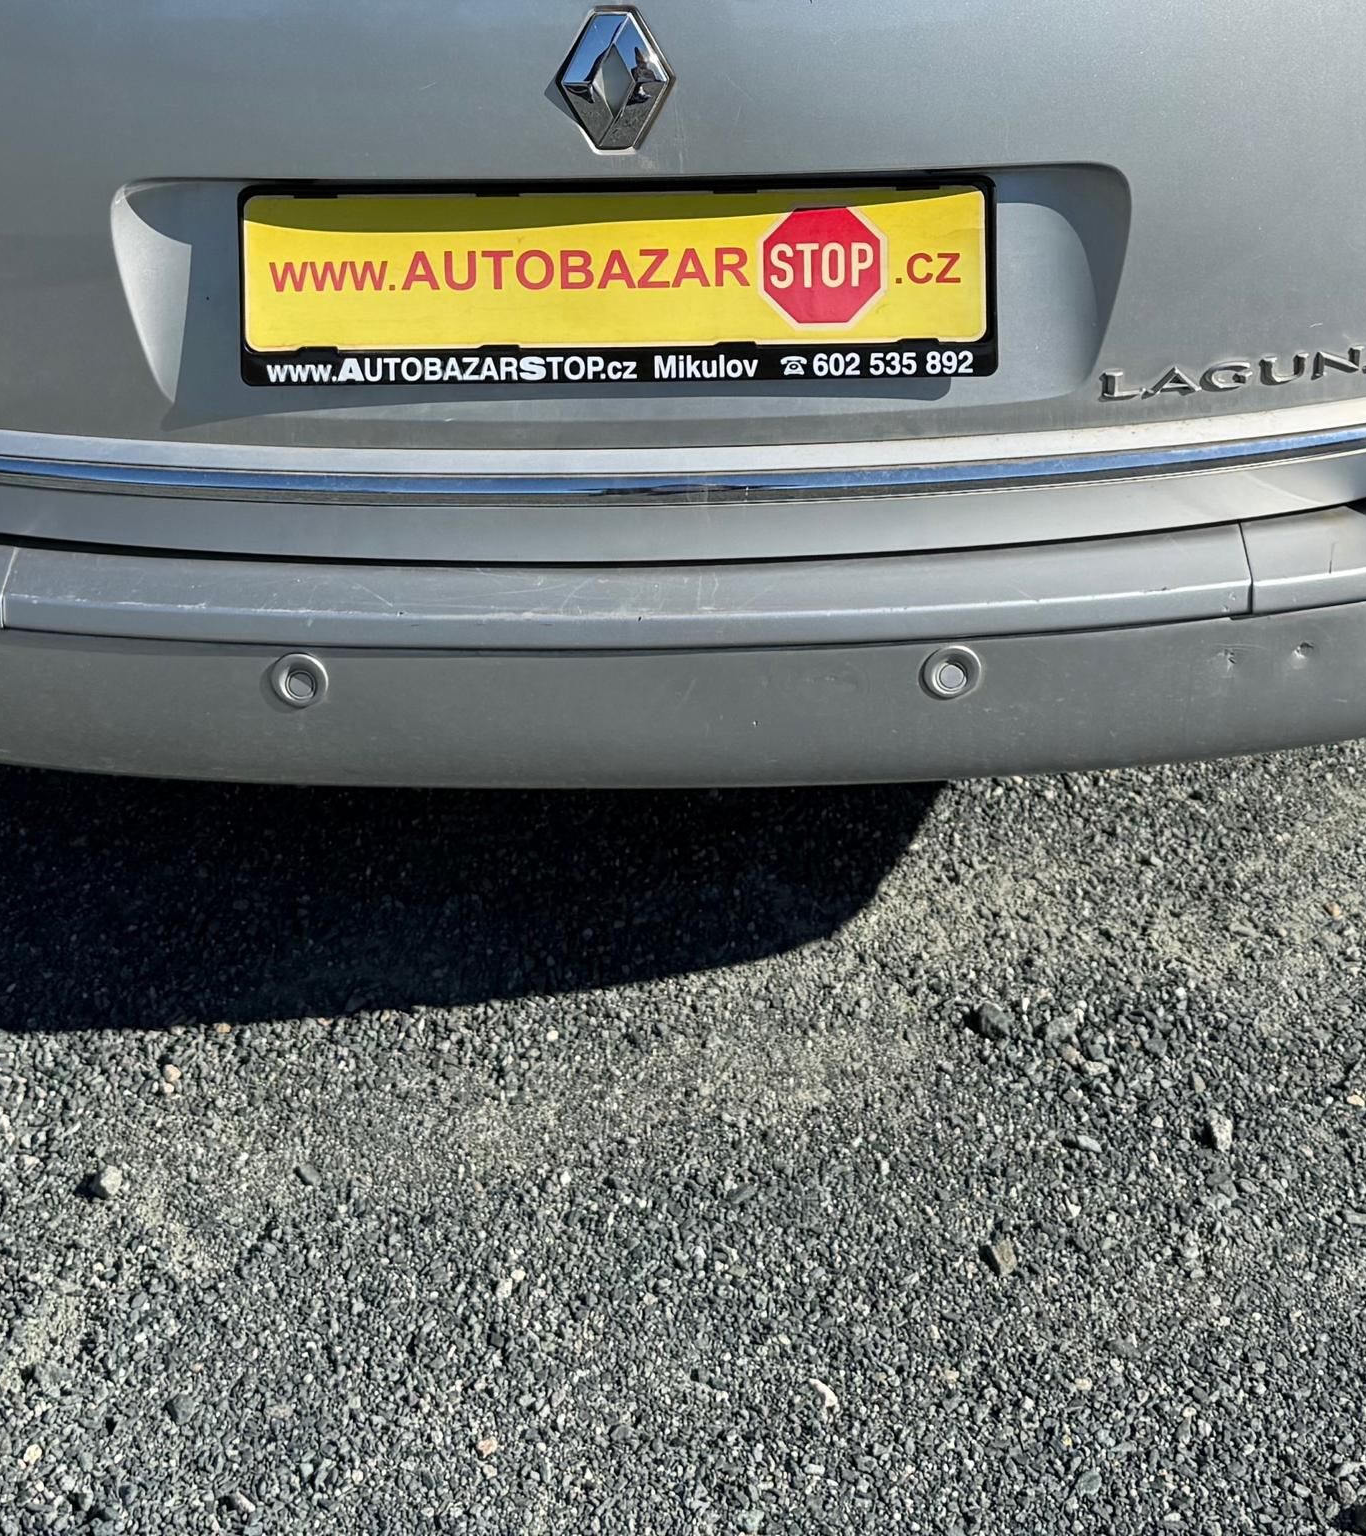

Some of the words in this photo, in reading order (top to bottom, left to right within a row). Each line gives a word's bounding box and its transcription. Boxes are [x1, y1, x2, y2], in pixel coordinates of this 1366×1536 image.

[769, 241, 875, 289] STOP
[653, 354, 759, 379] Mikulov
[812, 352, 862, 377] 602
[868, 351, 918, 376] 535
[925, 349, 975, 375] 892
